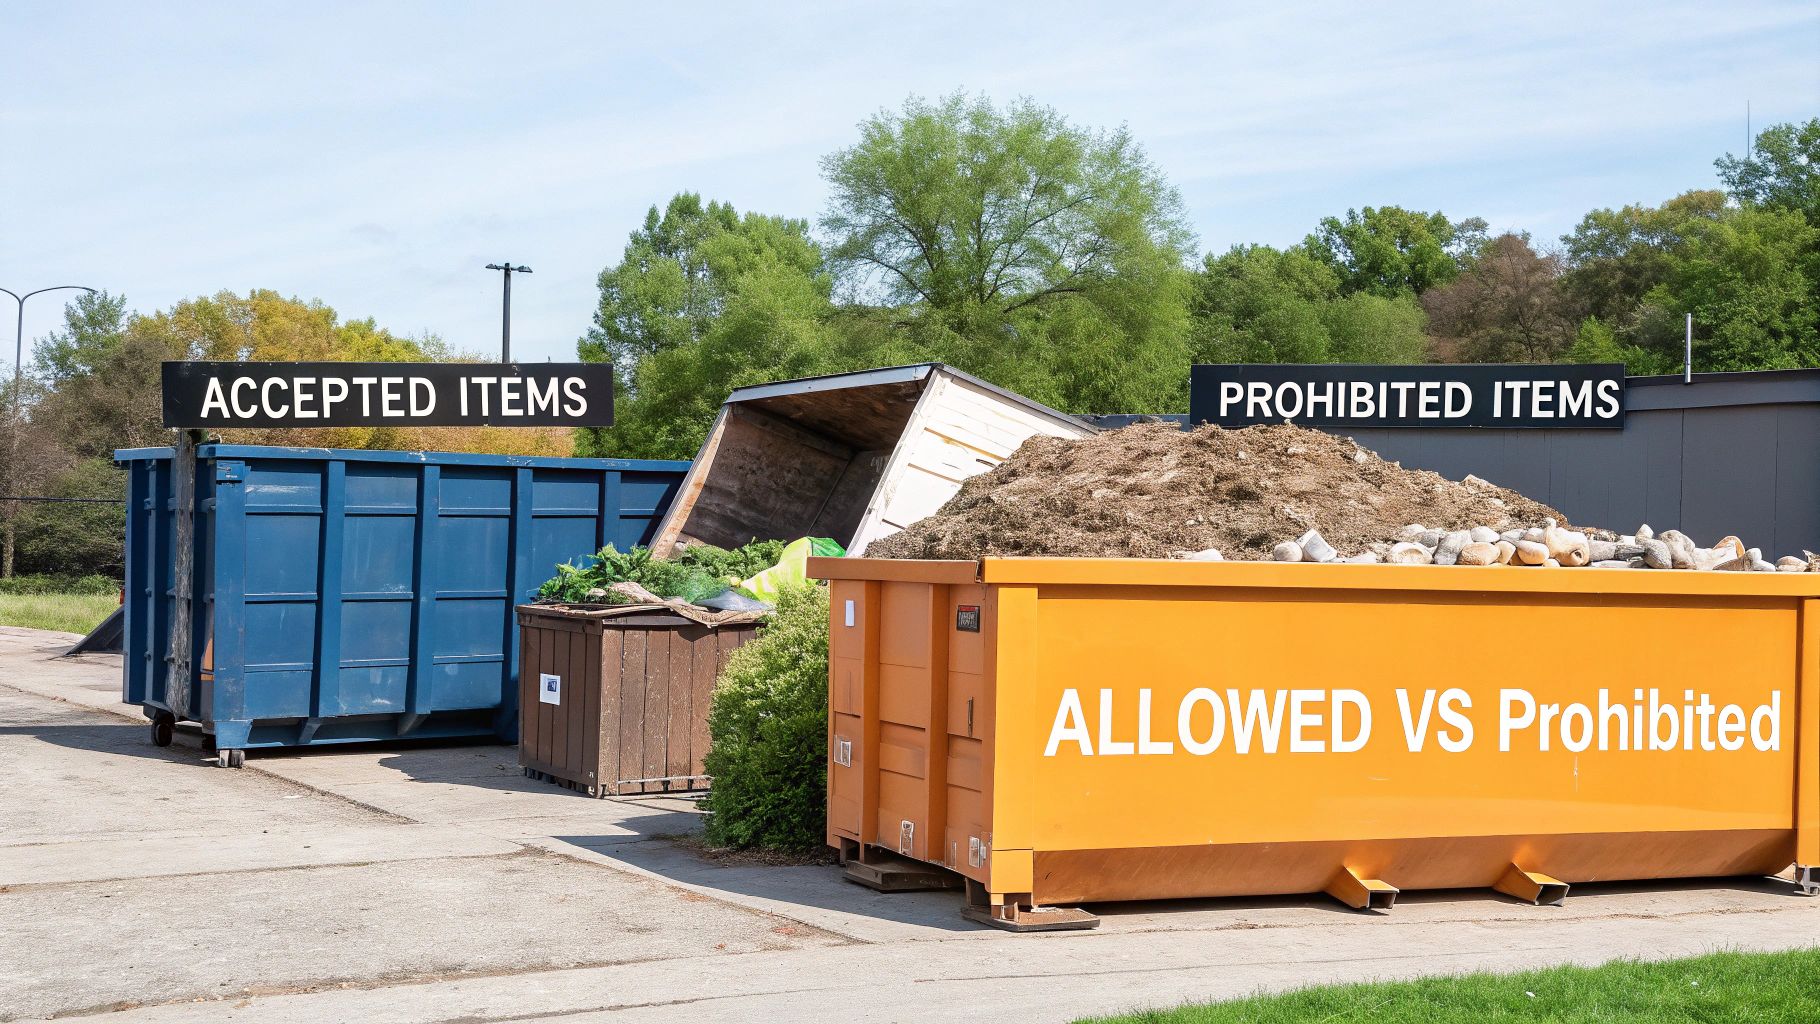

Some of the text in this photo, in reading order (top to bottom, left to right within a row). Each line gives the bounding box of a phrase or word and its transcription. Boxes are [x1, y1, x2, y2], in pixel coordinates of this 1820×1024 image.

[200, 376, 588, 419] ACCEPTED ITEMS
[1219, 379, 1620, 419] PROHIBITED ITEMS
[1043, 687, 1781, 757] ALLOWED VS Prohibited
